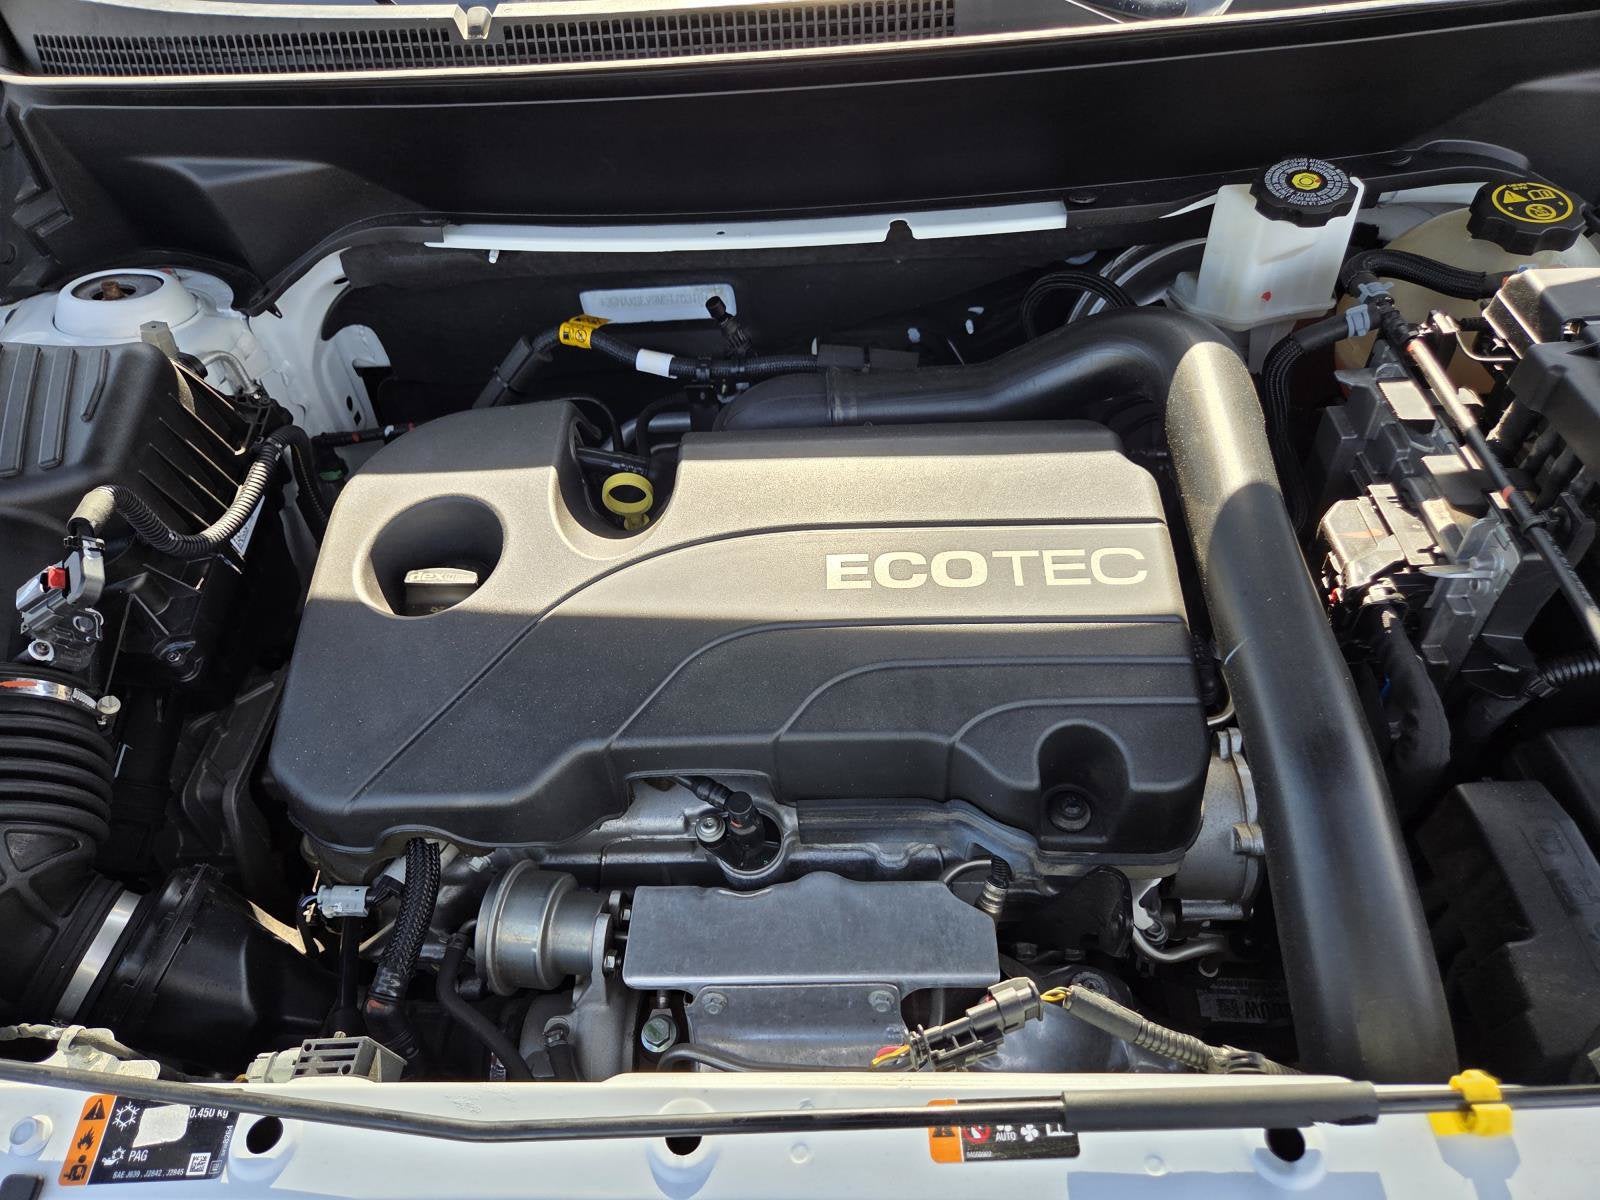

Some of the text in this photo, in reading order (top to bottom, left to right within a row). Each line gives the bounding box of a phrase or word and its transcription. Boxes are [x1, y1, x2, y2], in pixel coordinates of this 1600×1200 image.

[826, 547, 1148, 590] ECOTEC
[189, 1107, 215, 1118] 0.450
[995, 1132, 1017, 1142] AUTO
[128, 1149, 149, 1162] PAG
